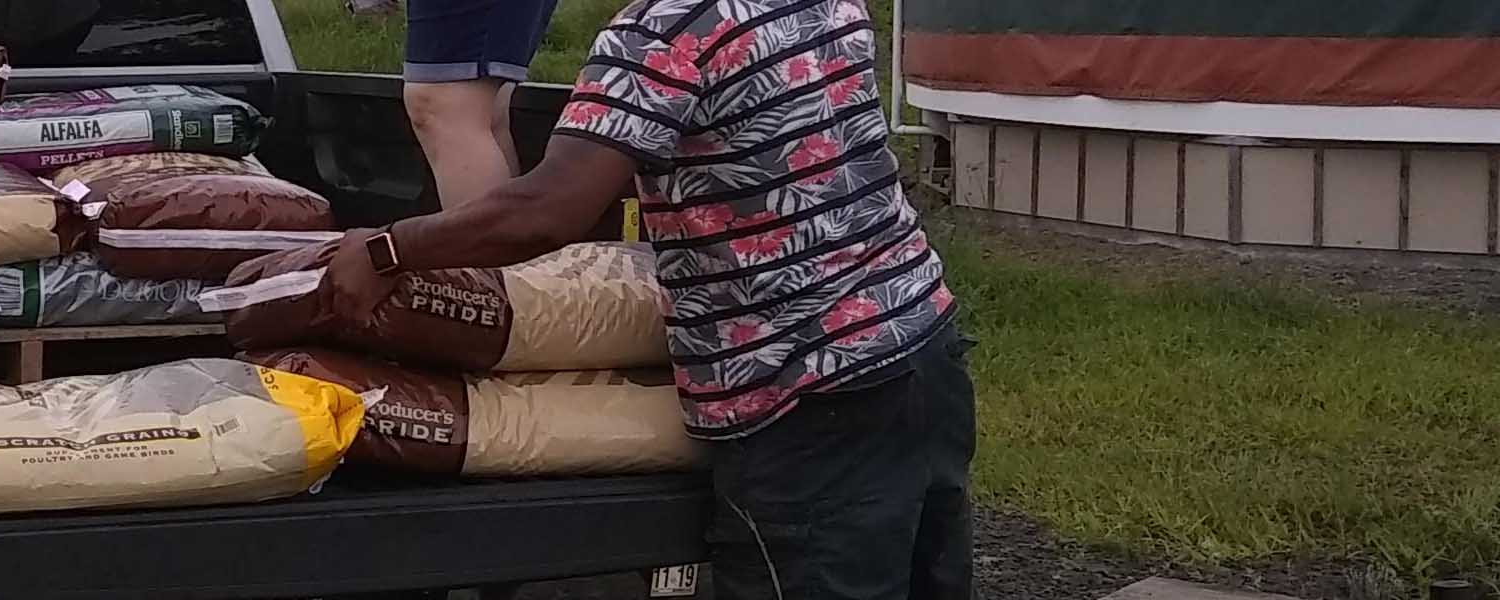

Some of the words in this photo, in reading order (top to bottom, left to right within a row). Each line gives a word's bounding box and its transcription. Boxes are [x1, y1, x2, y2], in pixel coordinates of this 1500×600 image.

[40, 119, 104, 143] ALFALFA
[411, 276, 500, 309] Producer's
[411, 295, 497, 326] PRIDE
[370, 401, 454, 425] oducer's
[106, 428, 189, 441] GRAINS
[21, 456, 73, 465] POULTRY
[104, 452, 136, 460] GAME
[140, 448, 175, 458] BIRDS
[677, 564, 695, 588] 19
